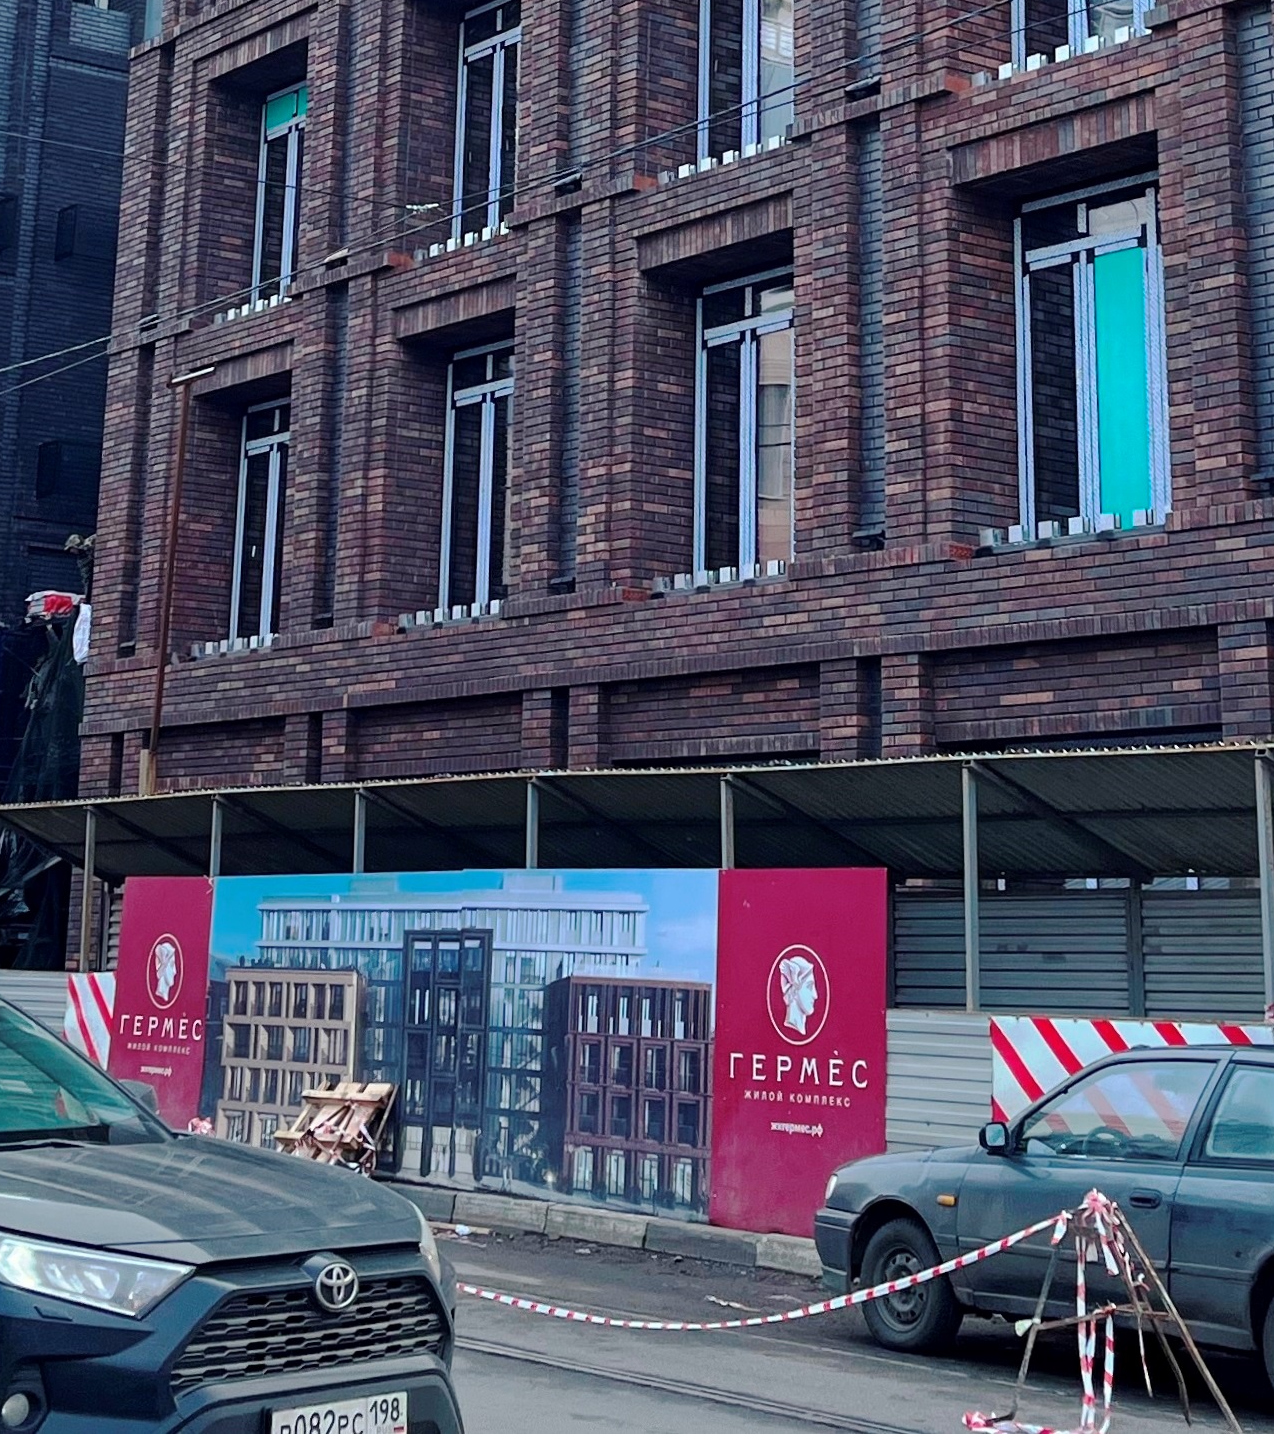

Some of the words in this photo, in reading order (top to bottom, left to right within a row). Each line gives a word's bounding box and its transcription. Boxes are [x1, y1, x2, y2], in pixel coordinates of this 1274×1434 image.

[744, 1089, 784, 1103] ЖИЛОЙ
[789, 1093, 851, 1107] КОМПЛЕКС
[369, 1397, 400, 1425] 198
